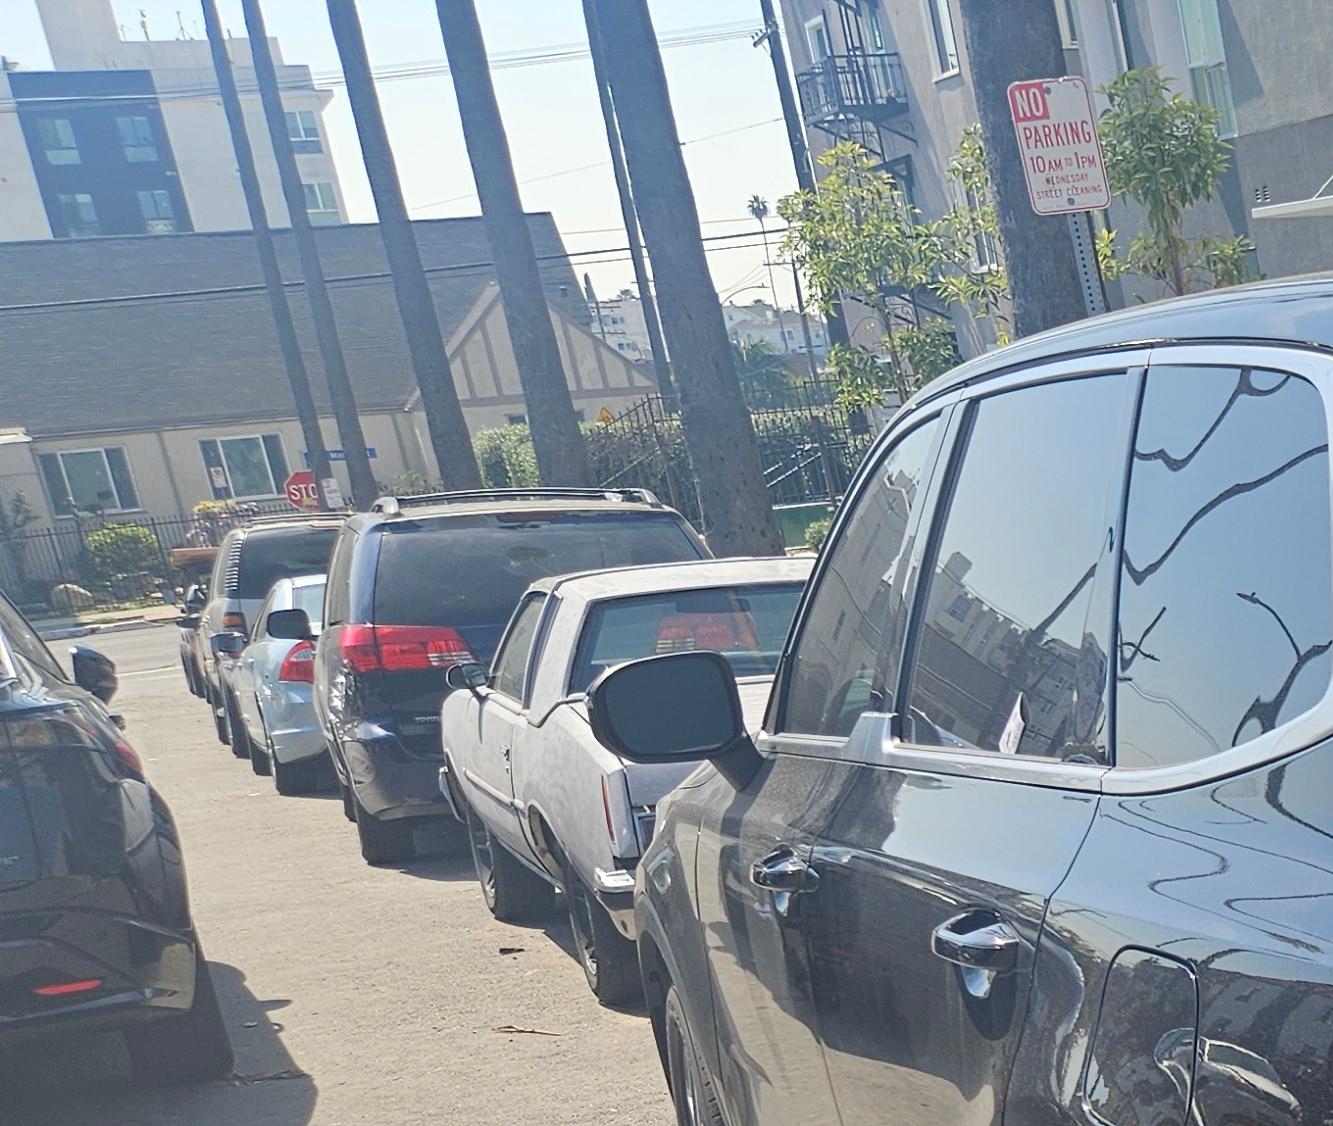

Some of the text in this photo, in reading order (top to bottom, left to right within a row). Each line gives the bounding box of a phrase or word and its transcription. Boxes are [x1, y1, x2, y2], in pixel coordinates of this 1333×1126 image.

[1015, 89, 1043, 118] NO
[1023, 120, 1092, 149] PARKING
[1045, 173, 1089, 186] WEDNESDAY
[1036, 185, 1103, 200] STREET CLEANING
[290, 484, 318, 500] STO
